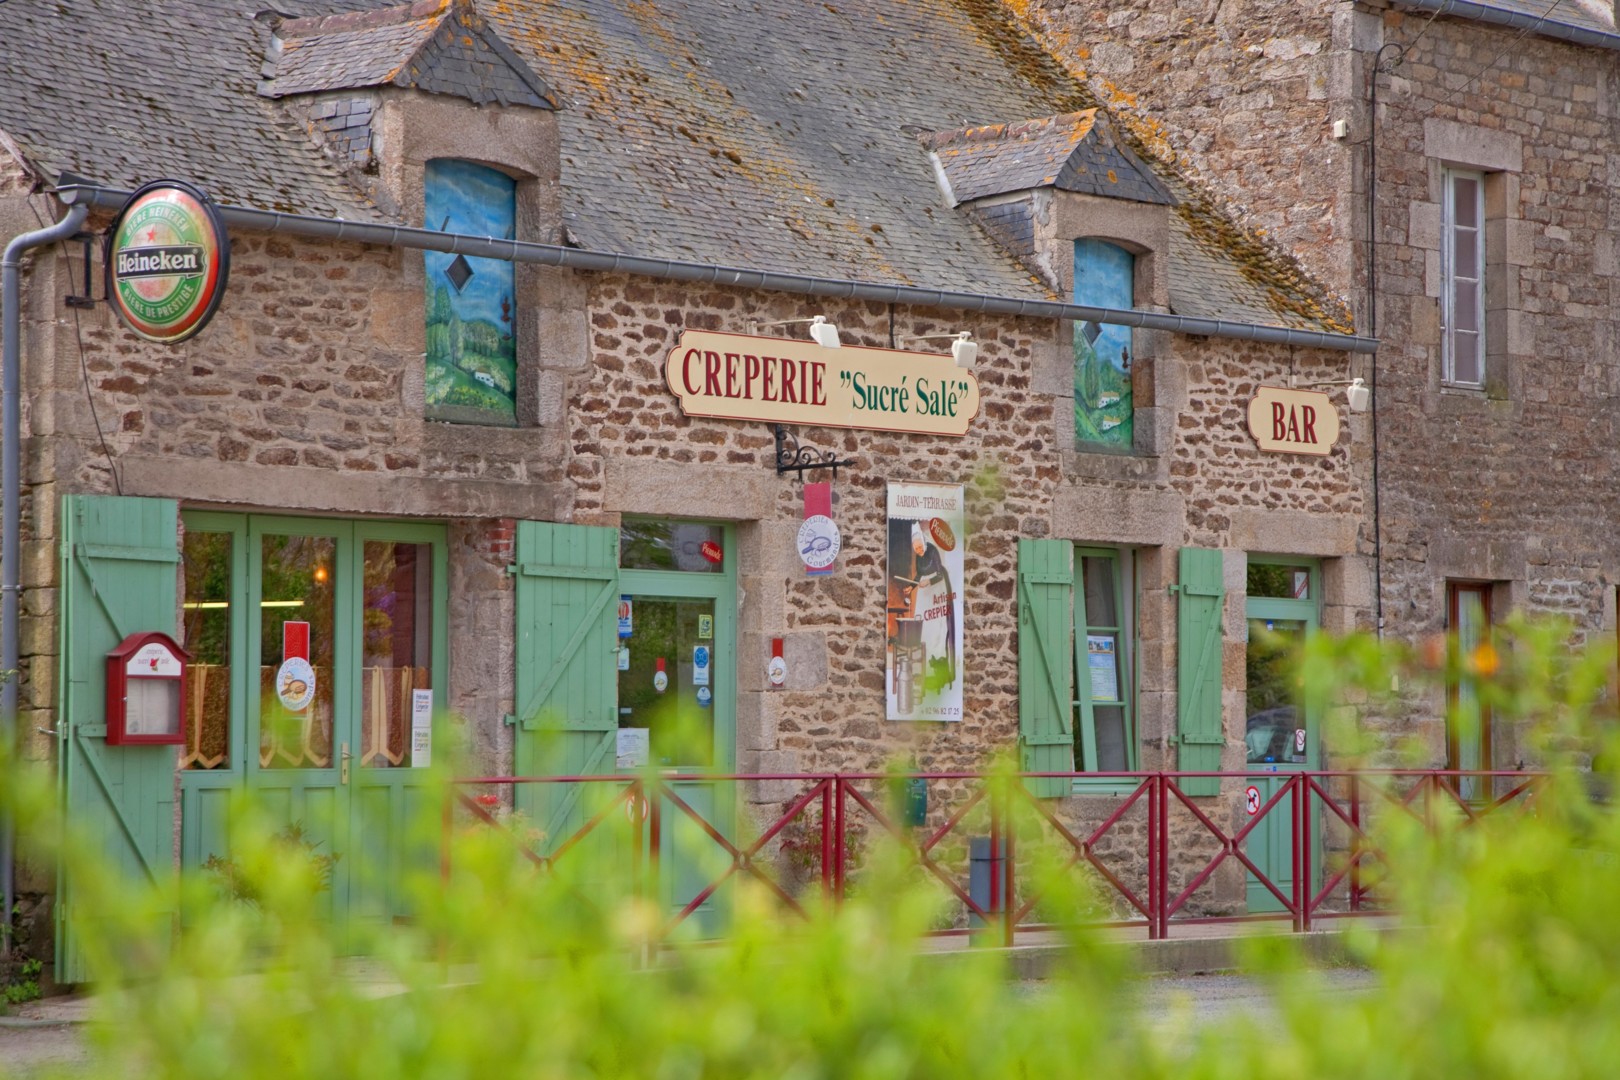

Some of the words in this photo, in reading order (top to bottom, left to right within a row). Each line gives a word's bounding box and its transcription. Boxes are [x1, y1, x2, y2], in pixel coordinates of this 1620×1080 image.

[150, 206, 190, 232] HEINEKEN
[118, 250, 197, 273] Heineken
[145, 307, 156, 318] DE
[158, 284, 194, 318] PRESTIGE
[682, 348, 828, 407] CREPERIE
[1271, 401, 1318, 444] BAR
[896, 494, 957, 511] JARDIN-TERRASSE
